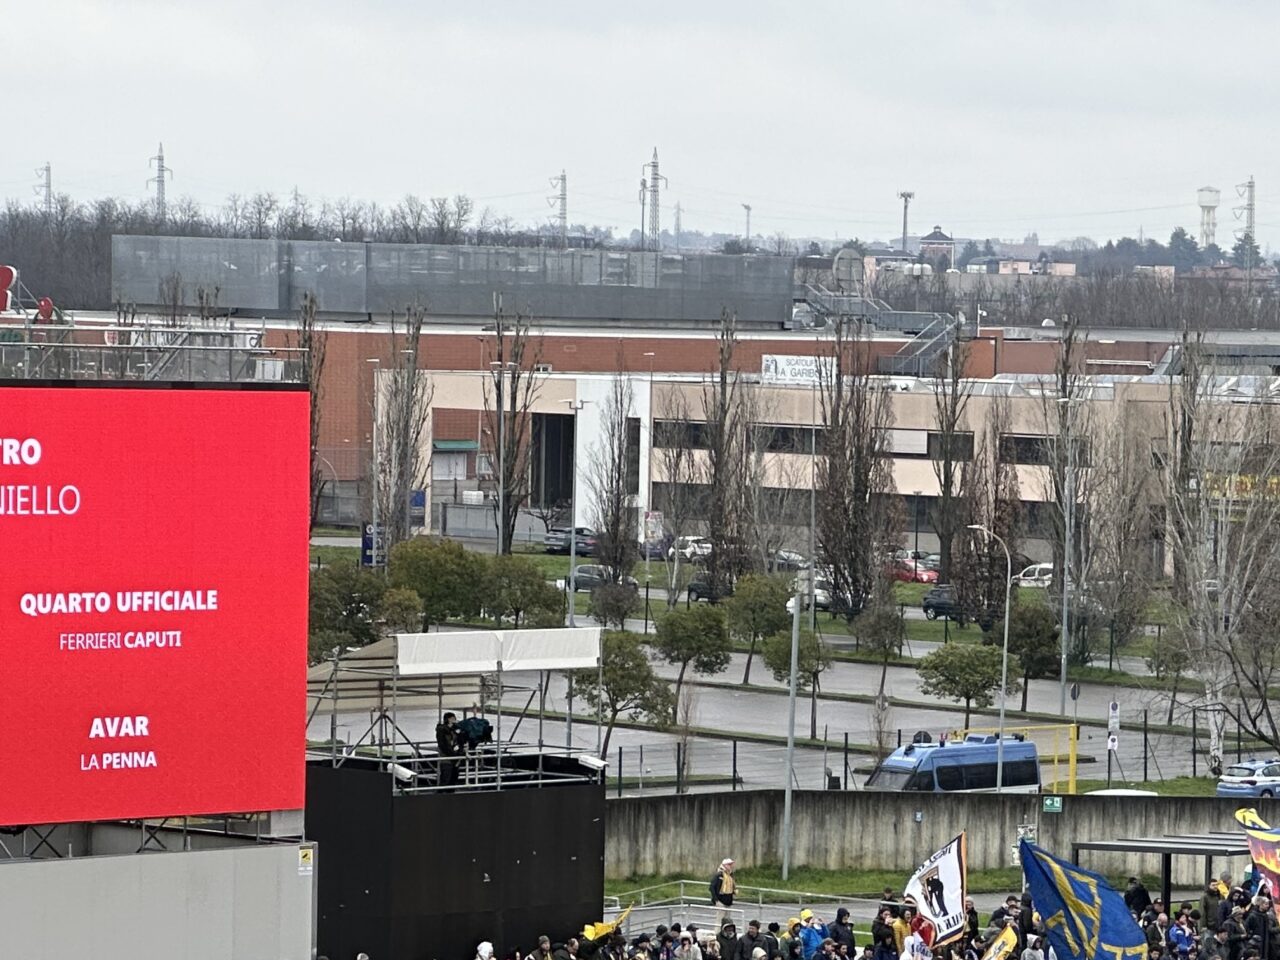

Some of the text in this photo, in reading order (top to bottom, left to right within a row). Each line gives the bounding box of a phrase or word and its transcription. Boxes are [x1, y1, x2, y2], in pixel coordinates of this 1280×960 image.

[20, 589, 218, 617] QUARTO UFFICIALE
[59, 630, 182, 651] FERRIERI CAPUTI
[89, 715, 149, 739] AVAR
[80, 751, 157, 771] LA PENNA
